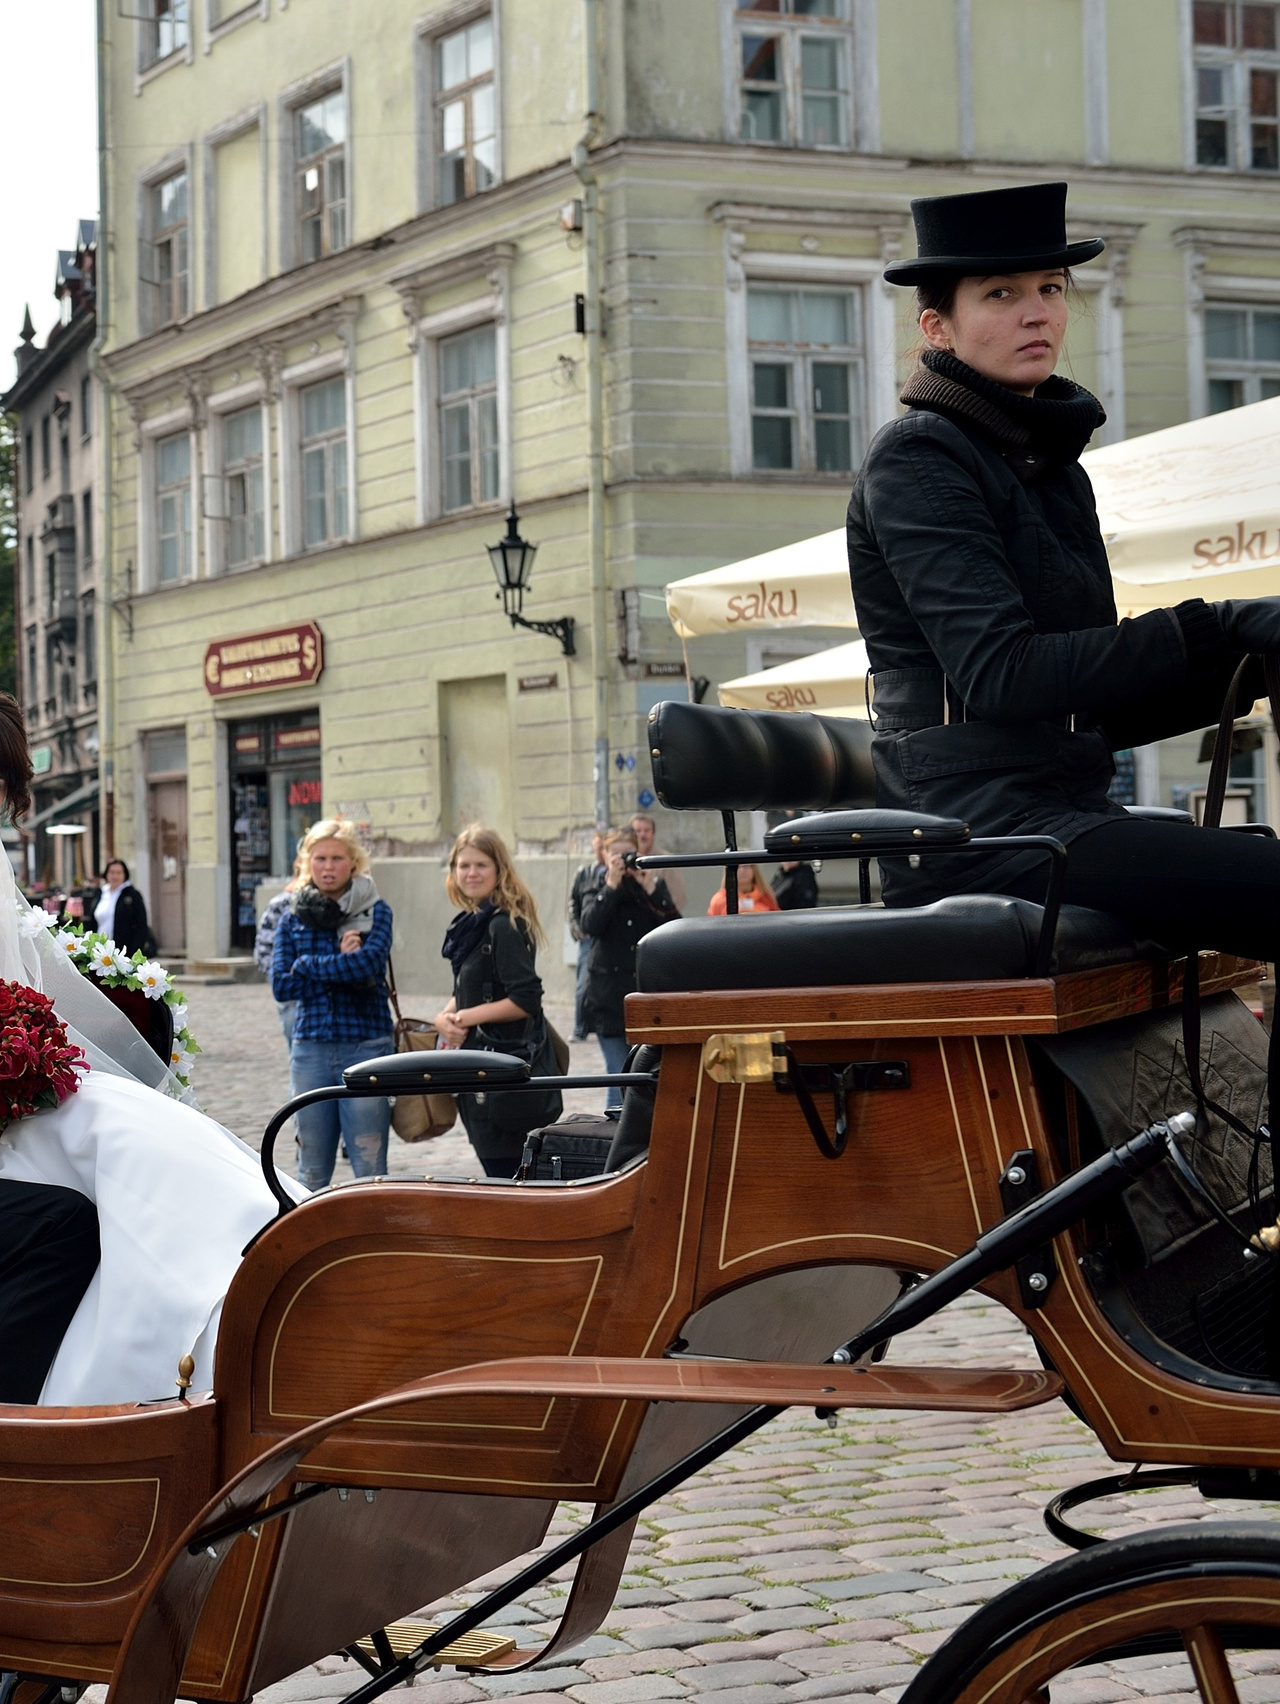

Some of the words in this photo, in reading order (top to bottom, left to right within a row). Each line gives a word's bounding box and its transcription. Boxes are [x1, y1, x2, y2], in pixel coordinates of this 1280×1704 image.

[1191, 520, 1280, 570] saku
[726, 581, 798, 624] saku
[765, 684, 817, 710] saku
